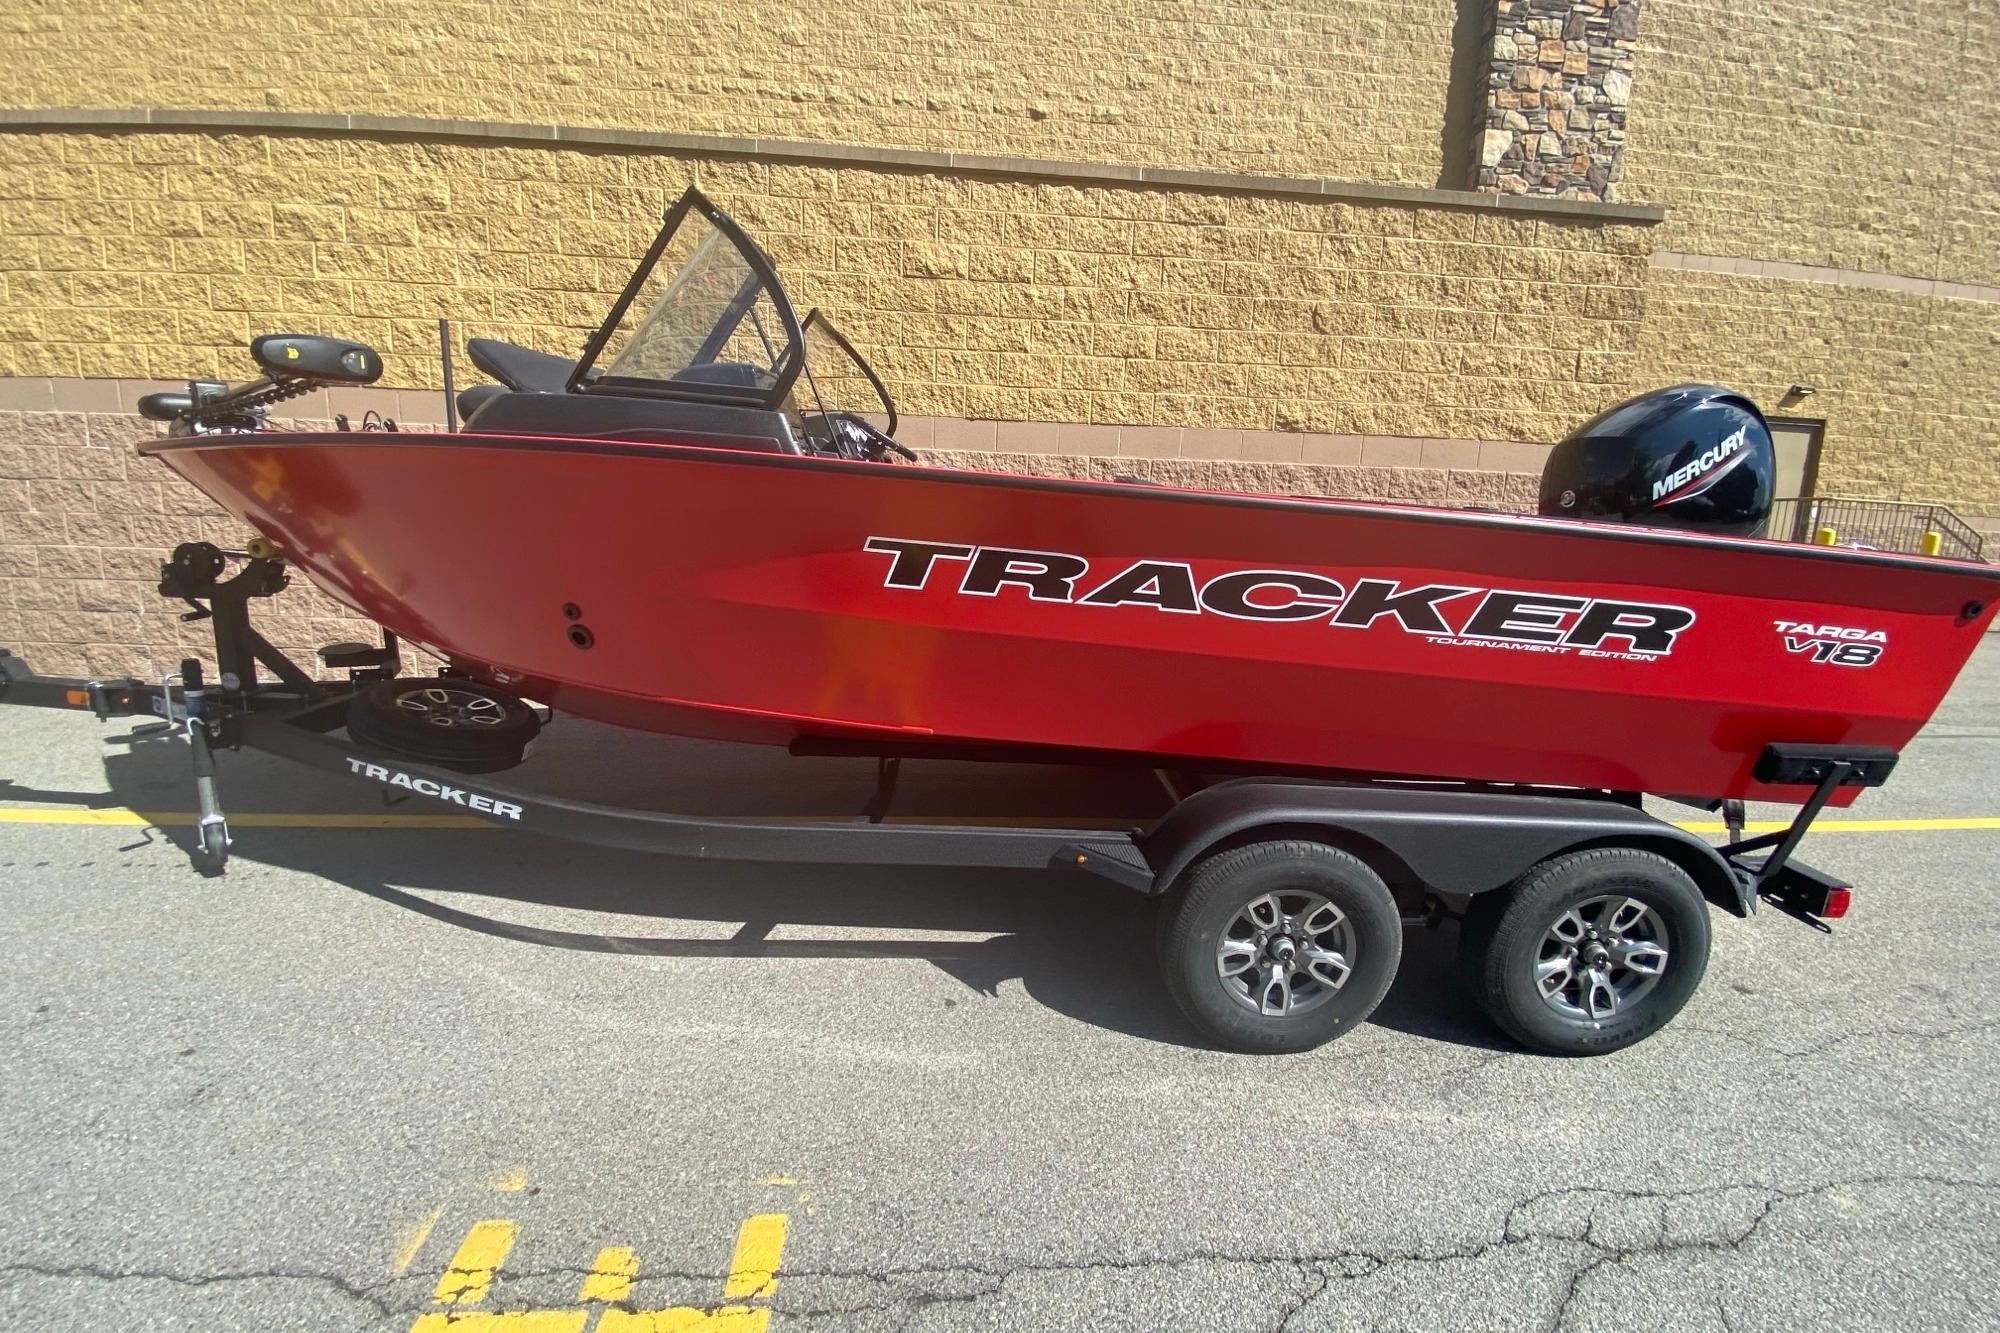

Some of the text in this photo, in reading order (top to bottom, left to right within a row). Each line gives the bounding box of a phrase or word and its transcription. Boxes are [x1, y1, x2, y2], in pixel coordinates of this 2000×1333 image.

[1652, 425, 1747, 501] MERCURY
[862, 535, 1697, 656] TRACKER
[1425, 636, 1658, 662] TOURNAMENT EDITION
[1773, 620, 1888, 643] TARGA
[1784, 636, 1883, 667] V18
[345, 757, 524, 821] TRACKER
